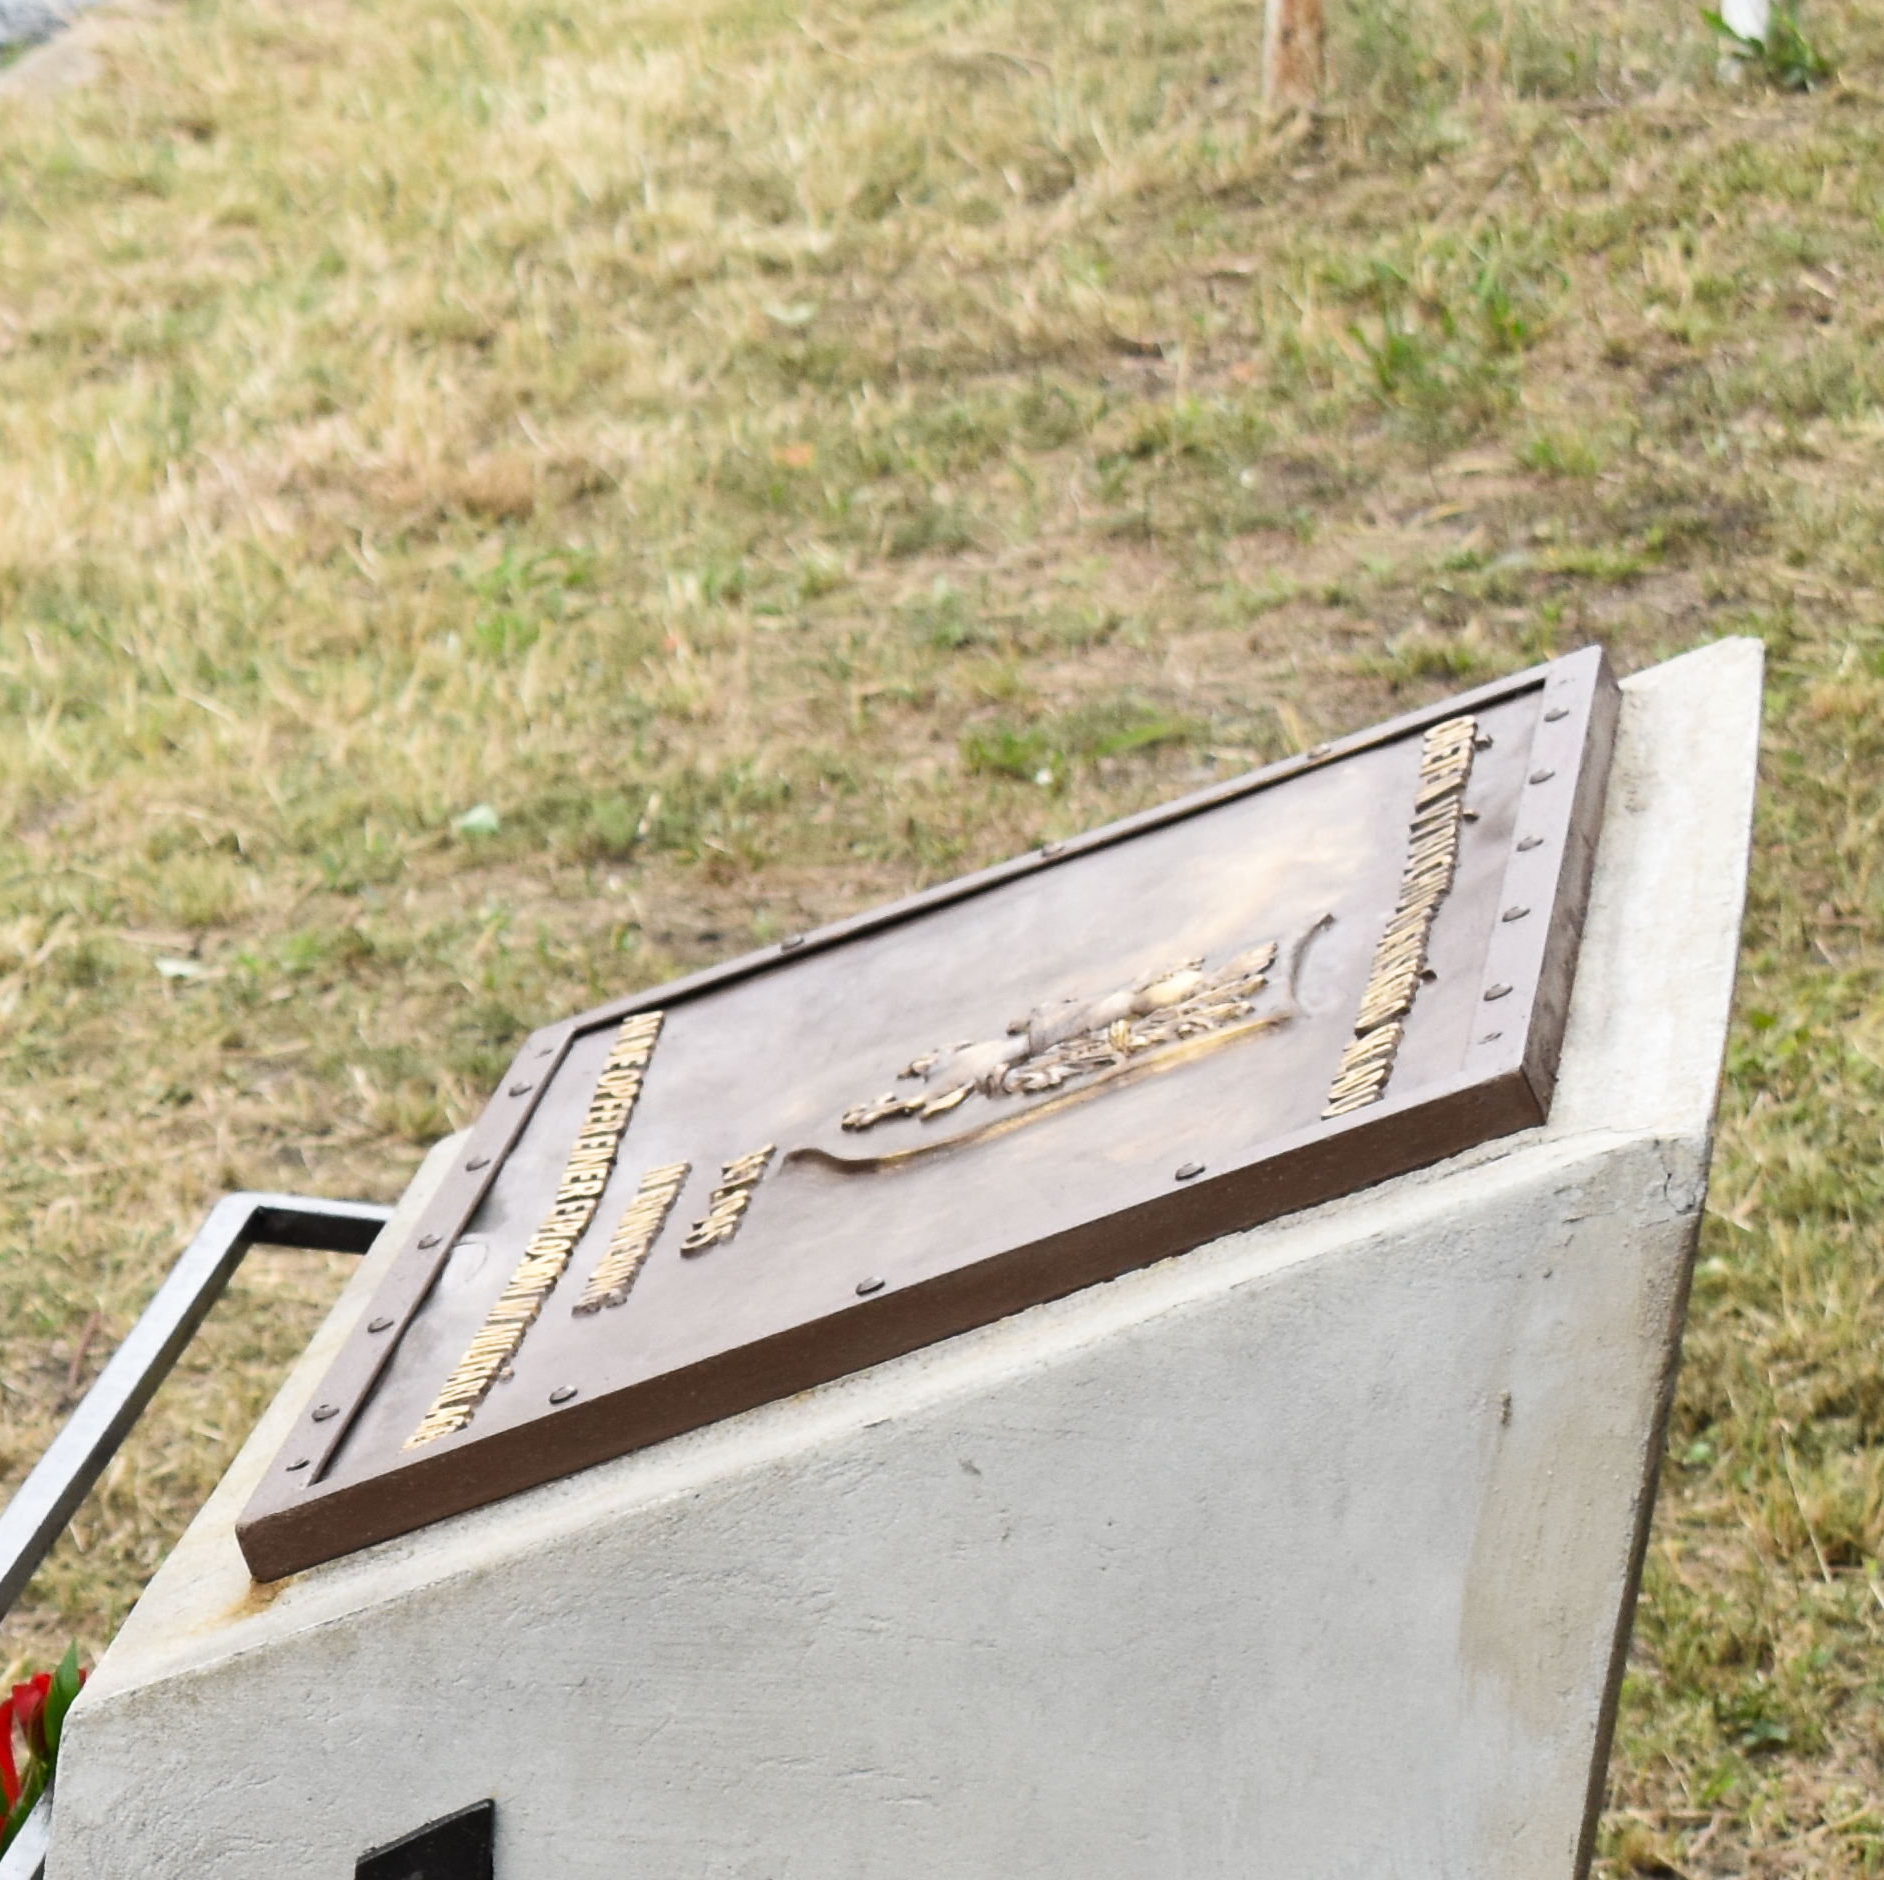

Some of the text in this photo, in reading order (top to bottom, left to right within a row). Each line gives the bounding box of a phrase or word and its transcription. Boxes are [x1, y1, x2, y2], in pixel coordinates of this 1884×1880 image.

[579, 1068, 642, 1138] OPFER
[1321, 1021, 1401, 1119] SKLADU
[556, 1134, 618, 1202] EINER
[501, 1198, 596, 1298] EXPLOSION
